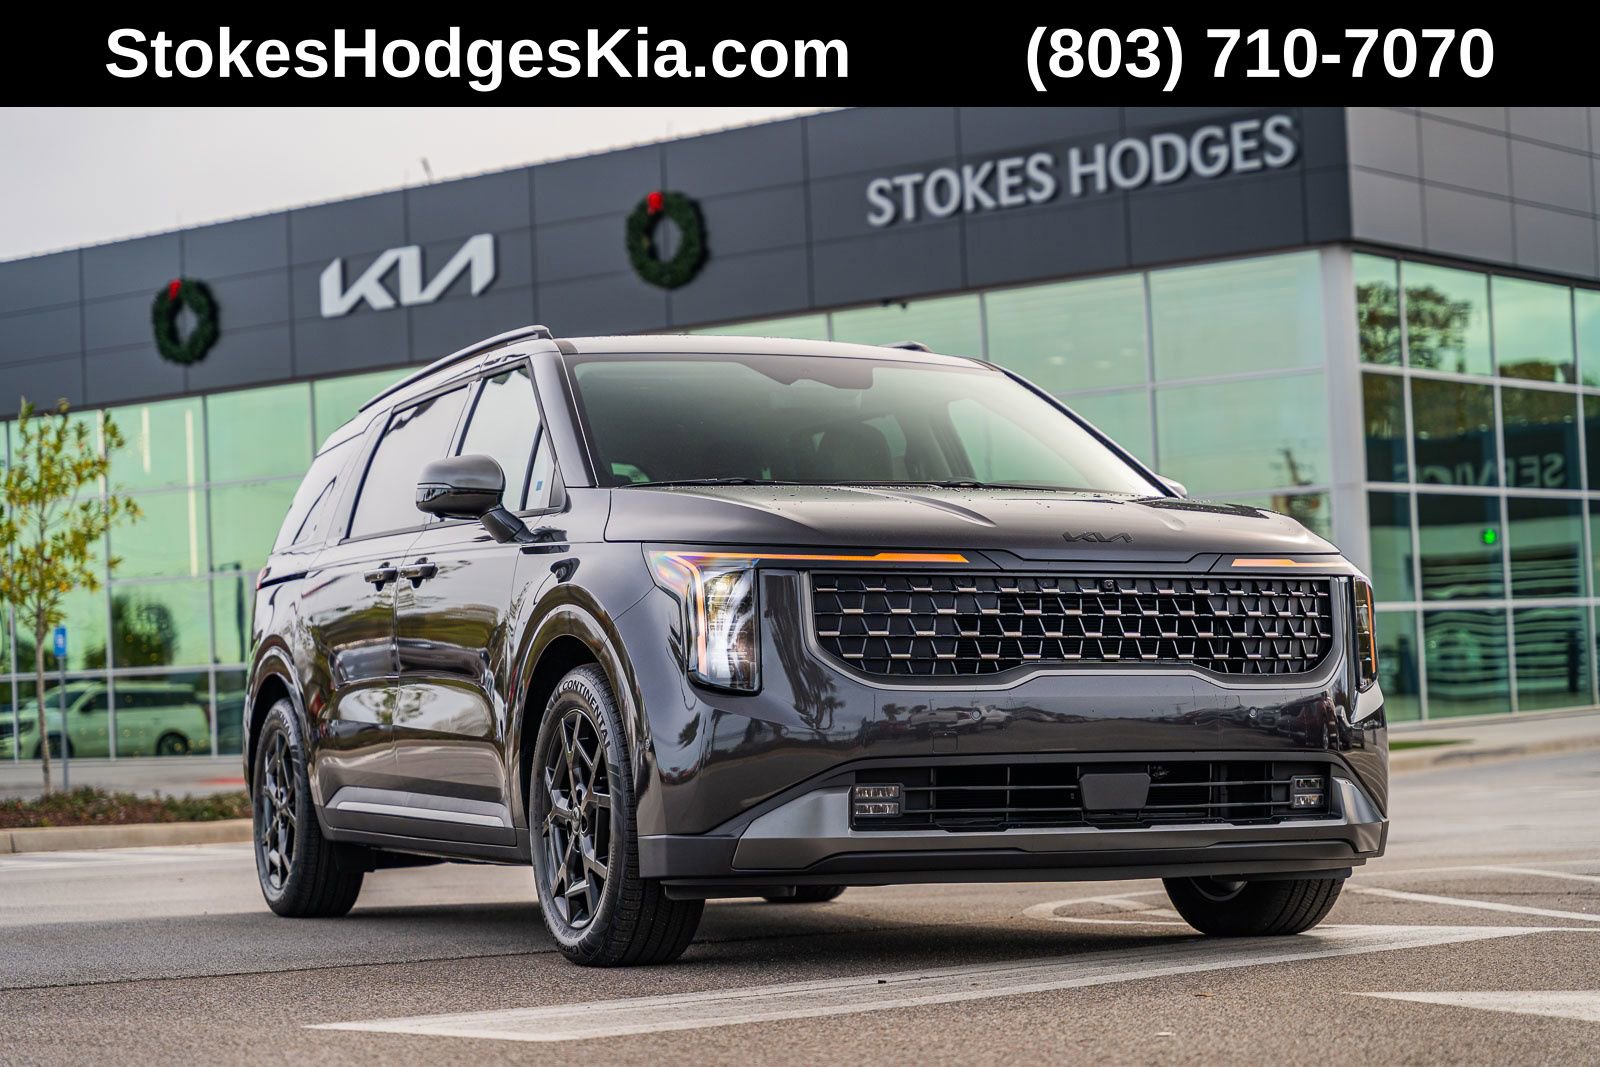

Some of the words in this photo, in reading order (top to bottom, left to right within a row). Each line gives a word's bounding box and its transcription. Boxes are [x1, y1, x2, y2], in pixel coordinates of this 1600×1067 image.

[866, 152, 1057, 227] STOKES
[1068, 114, 1297, 196] HODGES
[319, 232, 496, 319] KIA
[1062, 531, 1134, 544] KIA
[562, 679, 612, 751] CONTINENTAL
